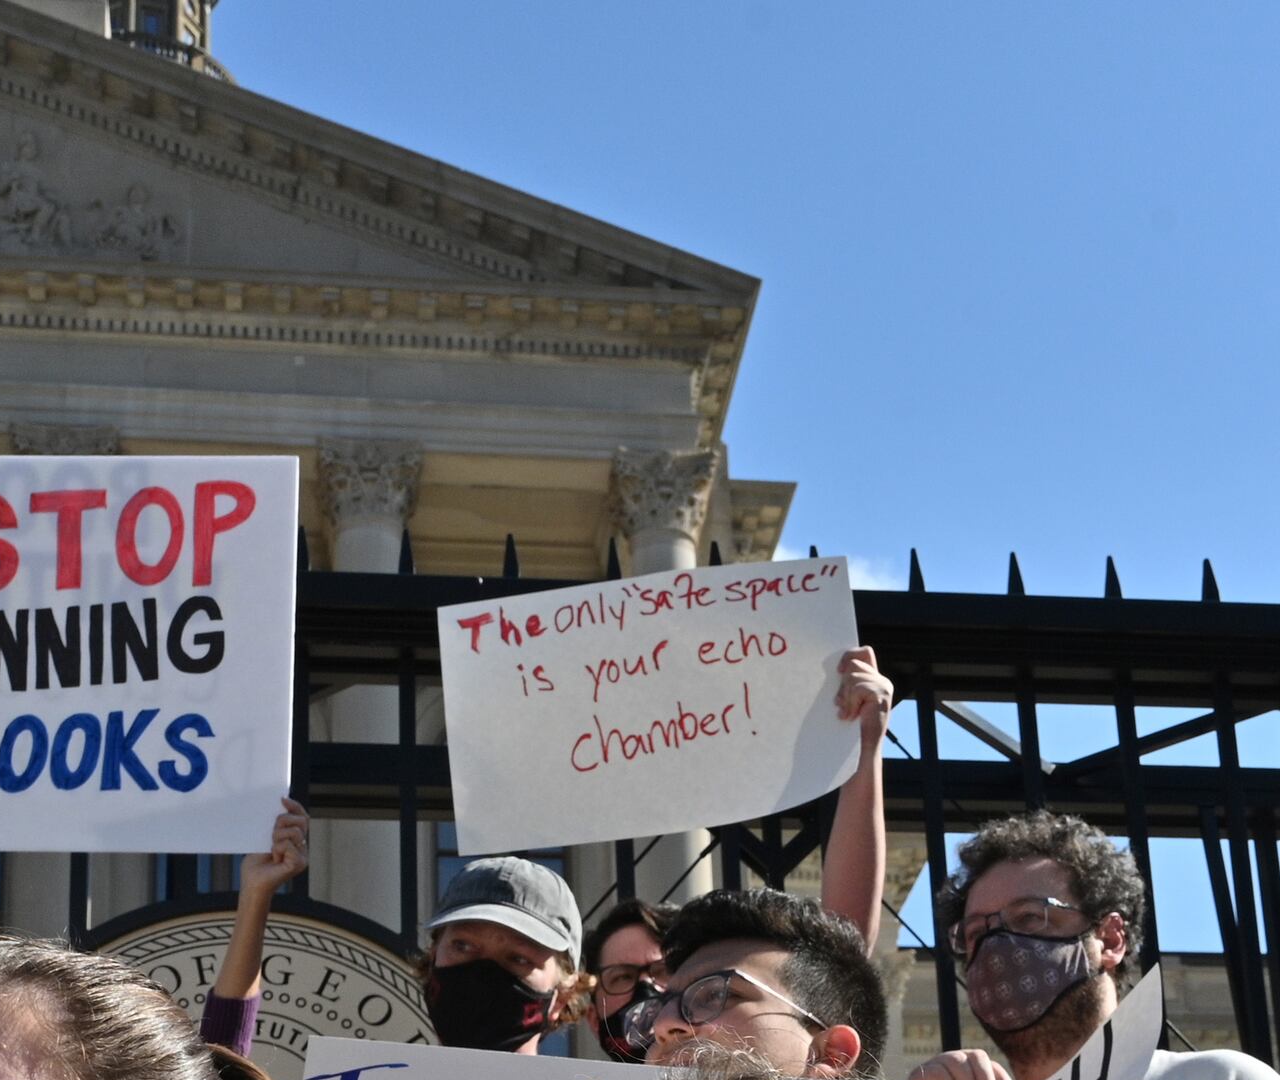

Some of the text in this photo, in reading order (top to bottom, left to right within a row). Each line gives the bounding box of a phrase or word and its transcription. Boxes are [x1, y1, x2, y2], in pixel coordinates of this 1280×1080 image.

[457, 607, 546, 653] The
[554, 592, 626, 631] only
[517, 627, 788, 702] is your echo
[571, 682, 758, 772] chamber!
[149, 953, 218, 994] OF
